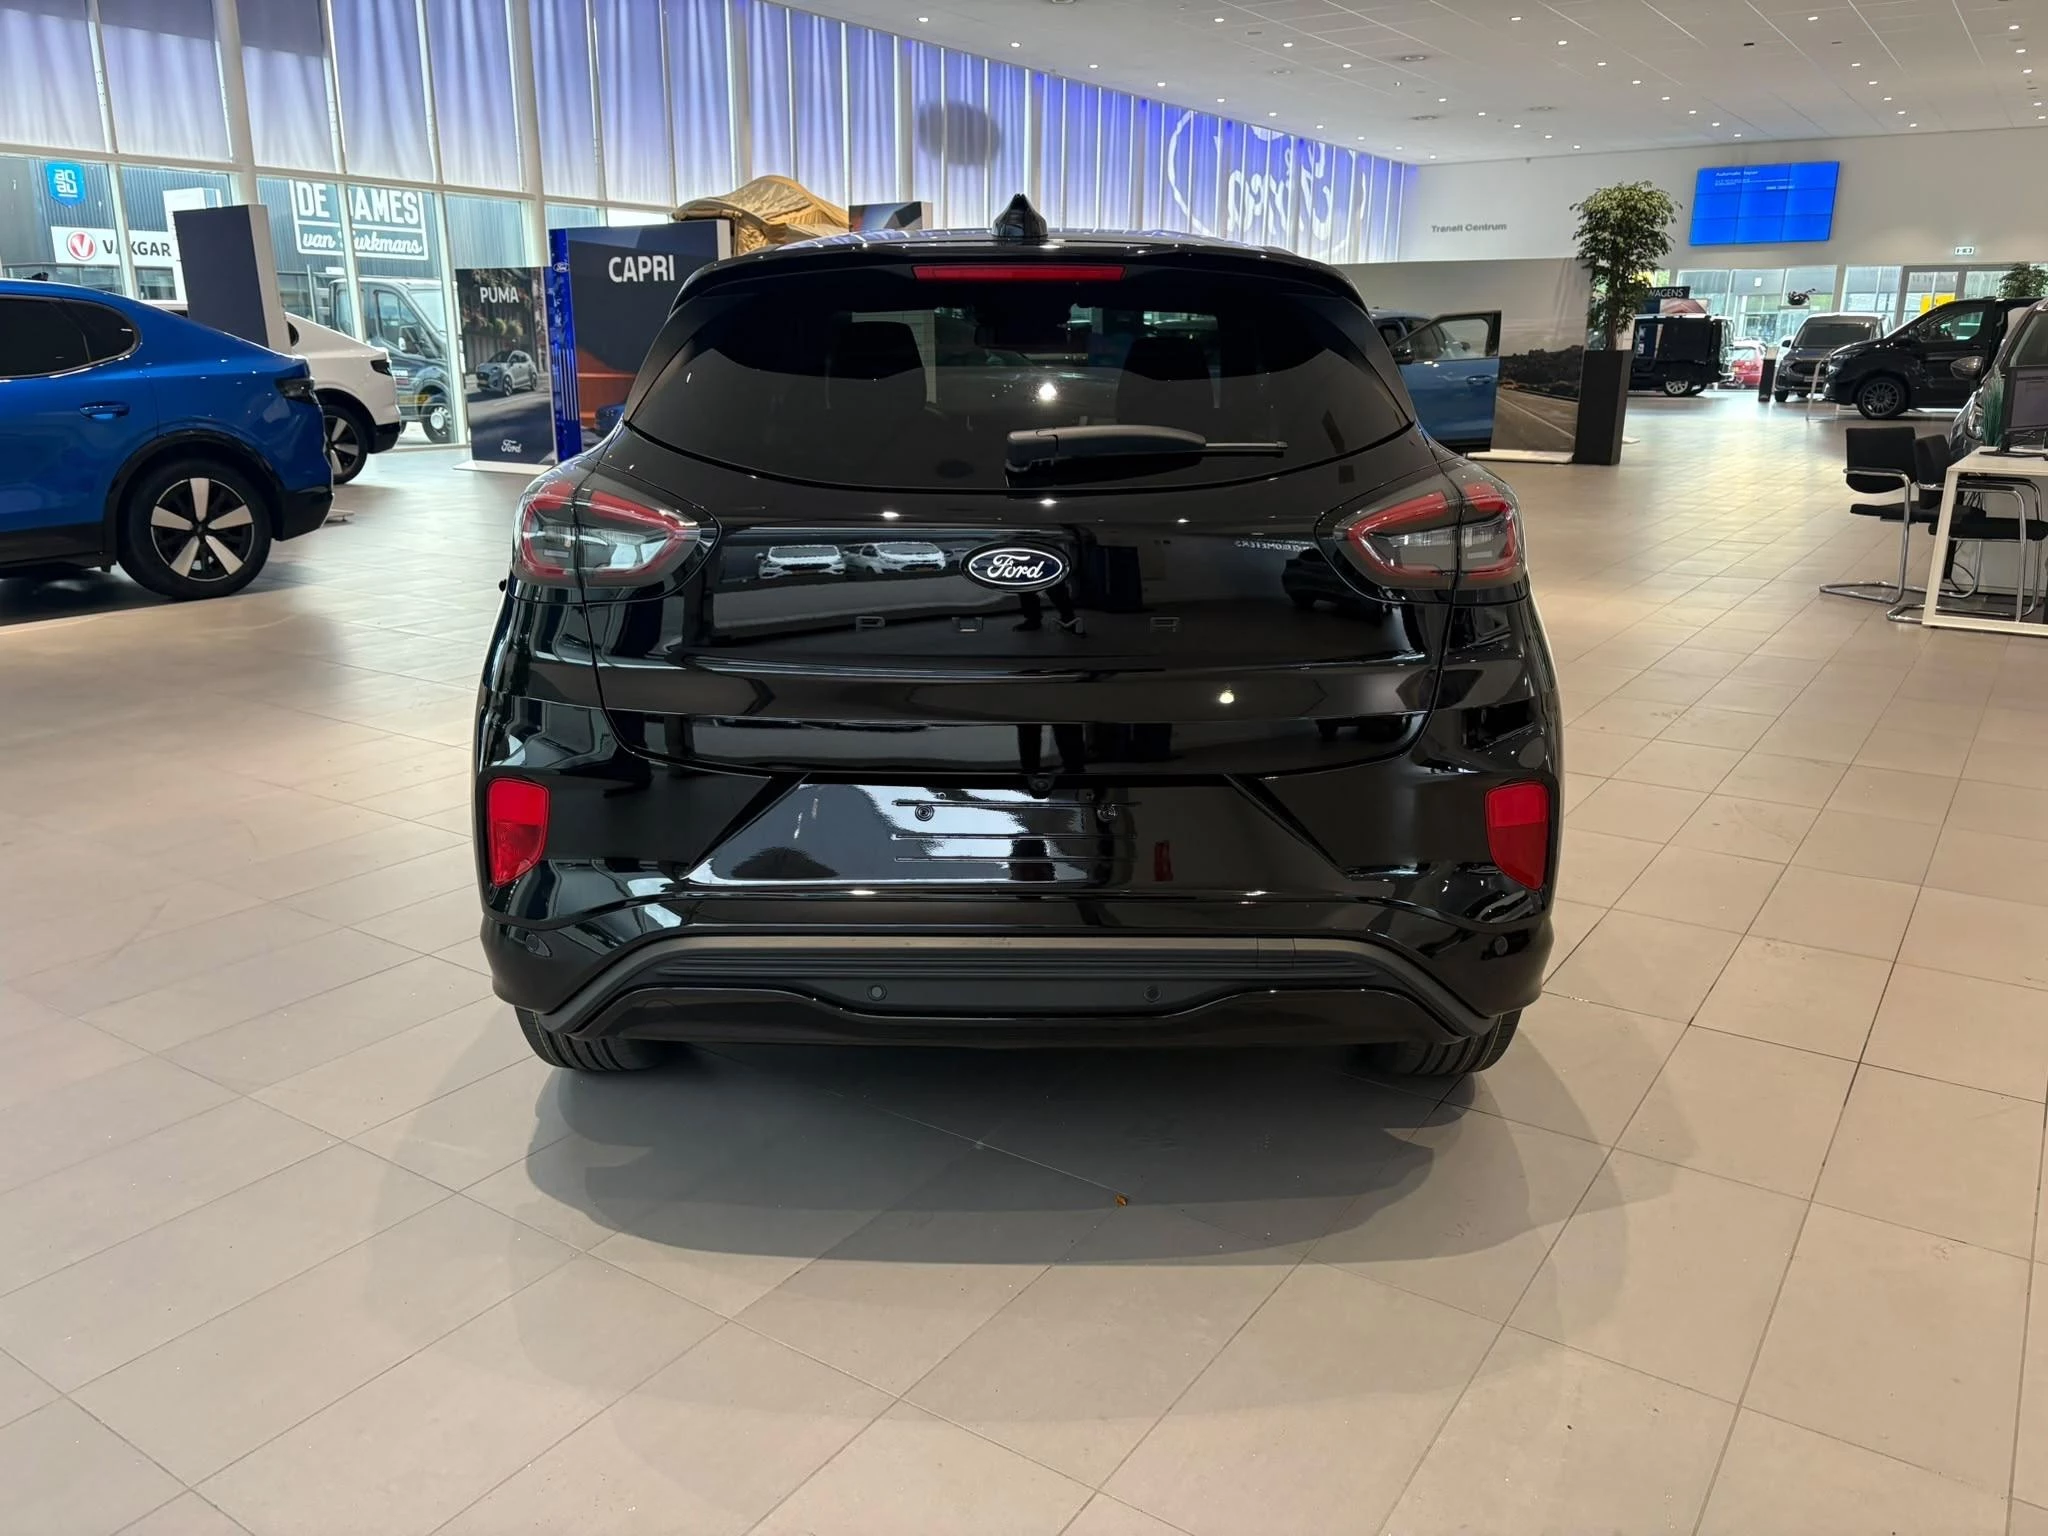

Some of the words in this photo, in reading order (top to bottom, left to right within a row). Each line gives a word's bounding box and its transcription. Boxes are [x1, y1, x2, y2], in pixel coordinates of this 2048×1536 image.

[296, 181, 330, 218] DE
[348, 187, 419, 225] AMES
[1464, 223, 1507, 232] Centrum
[103, 239, 172, 257] VKGAR
[302, 231, 336, 249] van
[608, 254, 676, 283] CAPRI
[479, 286, 520, 304] PUMA
[500, 439, 522, 453] Ford
[986, 554, 1045, 579] Ford
